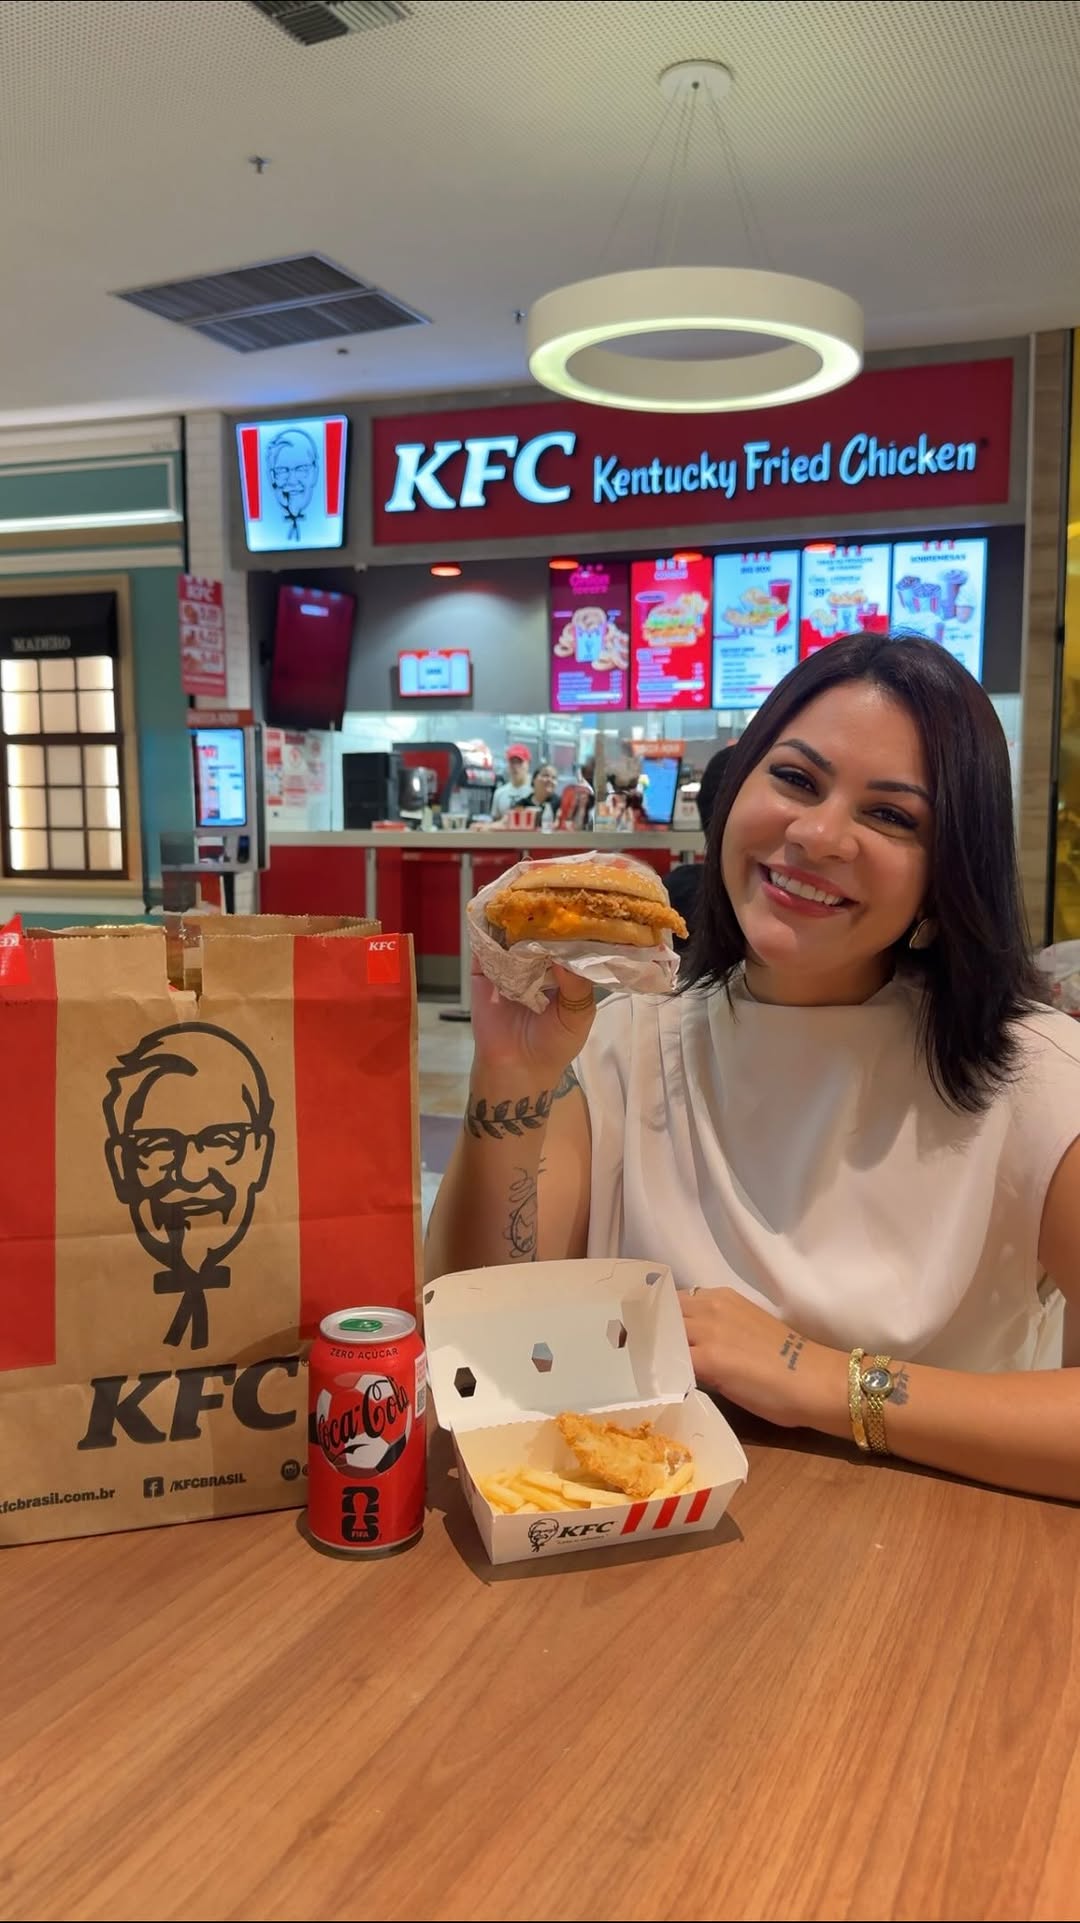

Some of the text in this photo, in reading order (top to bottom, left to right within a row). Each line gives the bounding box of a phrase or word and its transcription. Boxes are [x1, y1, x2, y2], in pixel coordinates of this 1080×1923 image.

[384, 431, 977, 513] KFC Kentucky Fried Chicken
[13, 636, 71, 651] MADERO
[368, 940, 397, 951] KFC
[330, 1347, 399, 1360] ZERO AÇÚCAR
[76, 1355, 301, 1451] KFC
[318, 1374, 409, 1452] Coca-Cola
[170, 1473, 247, 1493] /KFCBRASIL
[351, 1530, 369, 1539] FIFA
[556, 1520, 615, 1539] KFC
